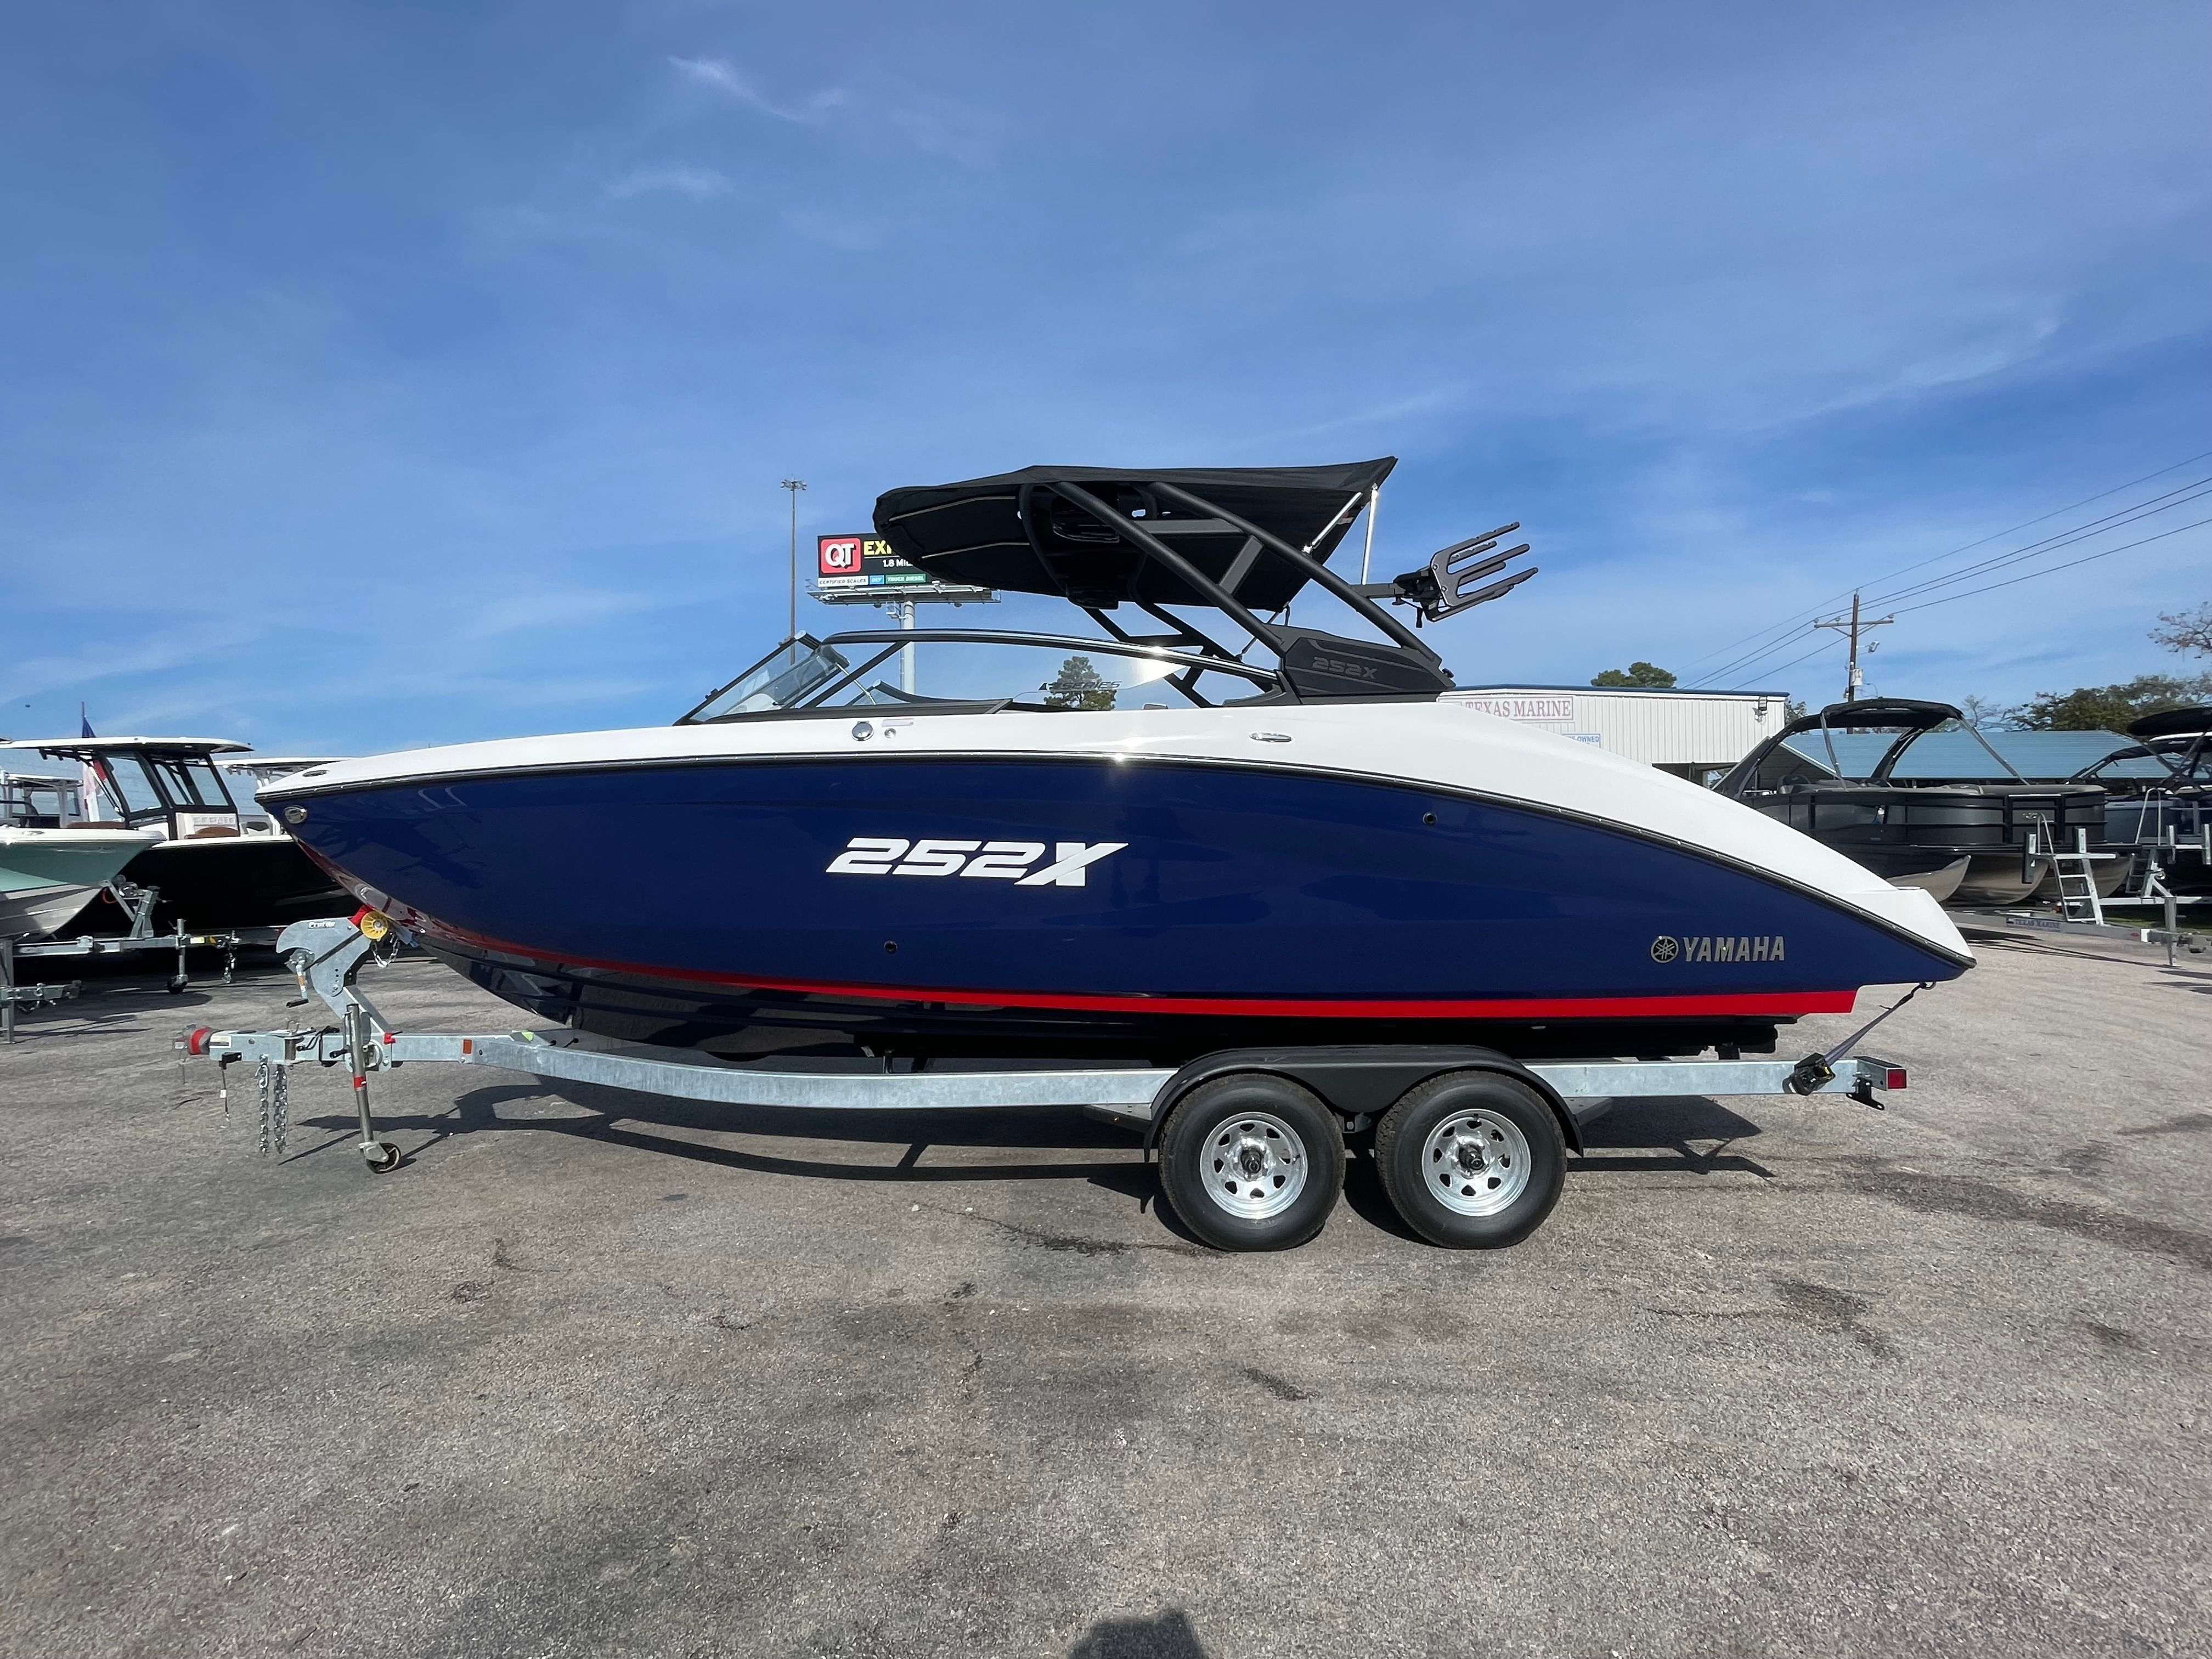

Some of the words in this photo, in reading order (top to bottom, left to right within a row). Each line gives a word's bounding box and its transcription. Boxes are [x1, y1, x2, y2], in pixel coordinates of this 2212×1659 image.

[826, 543, 855, 567] QT
[883, 559, 895, 567] 1.8
[1312, 656, 1378, 680] 252X
[1514, 700, 1571, 717] MARINE
[826, 837, 1128, 887] 252X
[1682, 936, 1785, 962] YAMAHA
